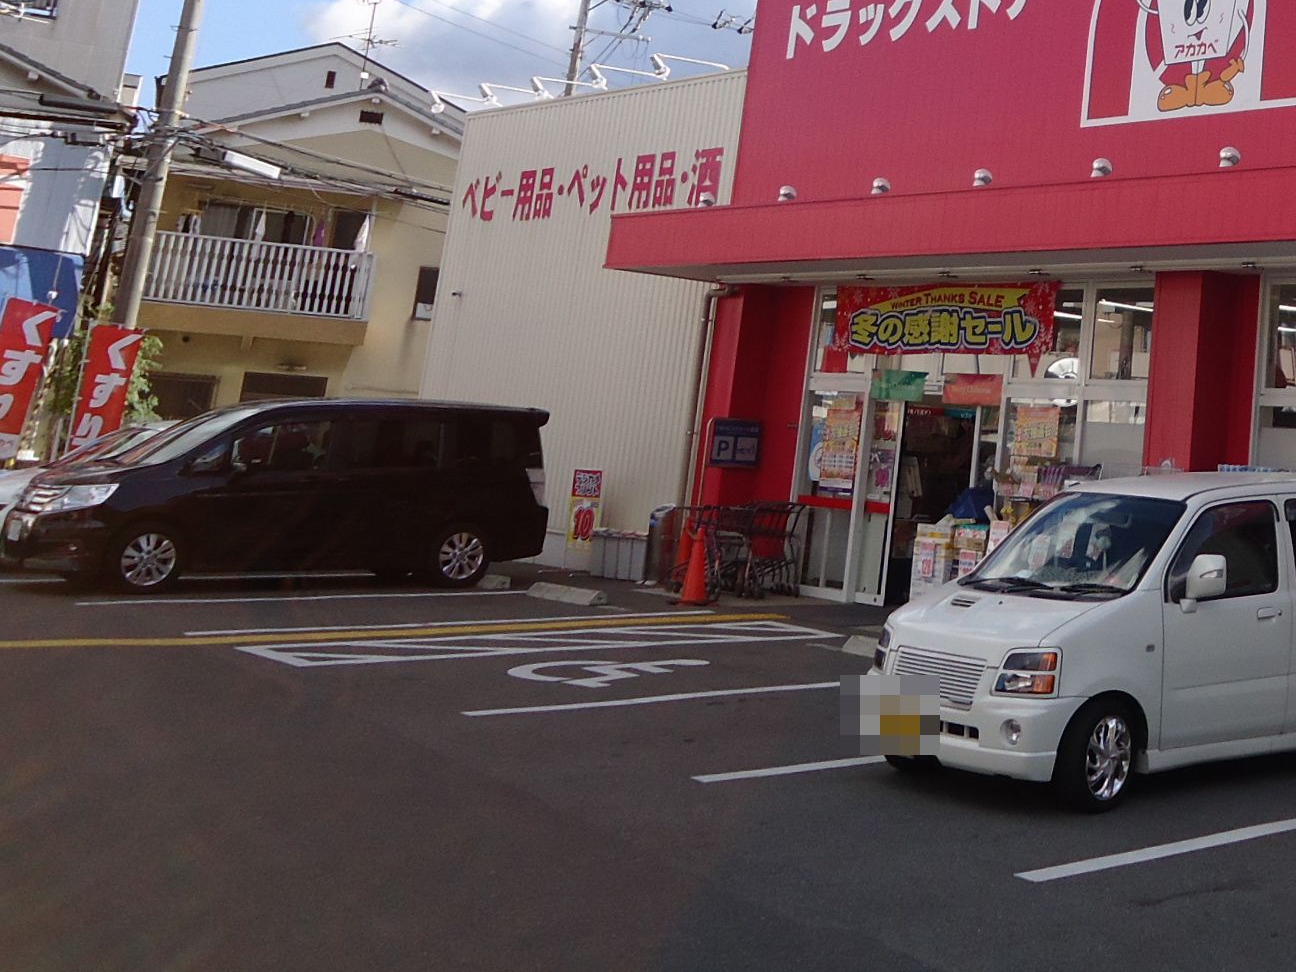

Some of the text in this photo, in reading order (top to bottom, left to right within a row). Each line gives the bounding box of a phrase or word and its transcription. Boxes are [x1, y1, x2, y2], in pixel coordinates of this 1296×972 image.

[1174, 39, 1219, 59] アカカベ
[890, 290, 1005, 310] WINTER THANKS SALE
[851, 310, 1037, 347] 冬の感謝セール
